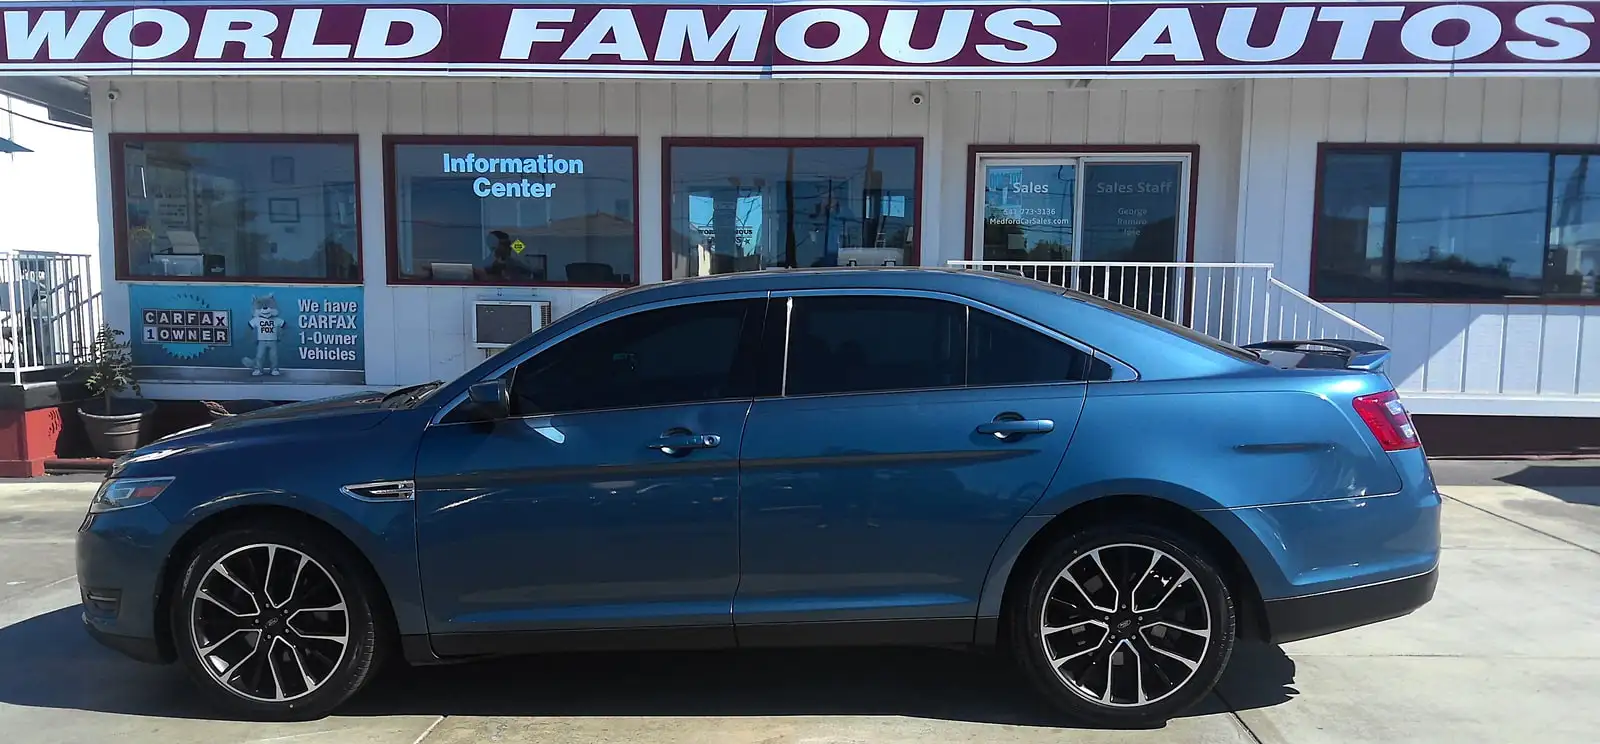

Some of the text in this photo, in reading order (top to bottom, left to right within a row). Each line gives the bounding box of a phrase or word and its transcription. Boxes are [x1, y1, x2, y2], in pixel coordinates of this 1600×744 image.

[3, 4, 1596, 63] WORLD FAMOUS AUTOS
[443, 153, 584, 174] Information
[473, 177, 556, 198] Center
[1012, 181, 1049, 194] Sales
[1096, 181, 1173, 194] Sales Staff
[989, 217, 1069, 225] MedfordCarSales.com
[298, 299, 357, 313] We have
[145, 312, 226, 327] CARFAX
[298, 315, 357, 329] CARFAX
[147, 328, 226, 341] 1 OWNER
[299, 331, 358, 345] 1-Owner
[299, 347, 356, 361] Vehicles
